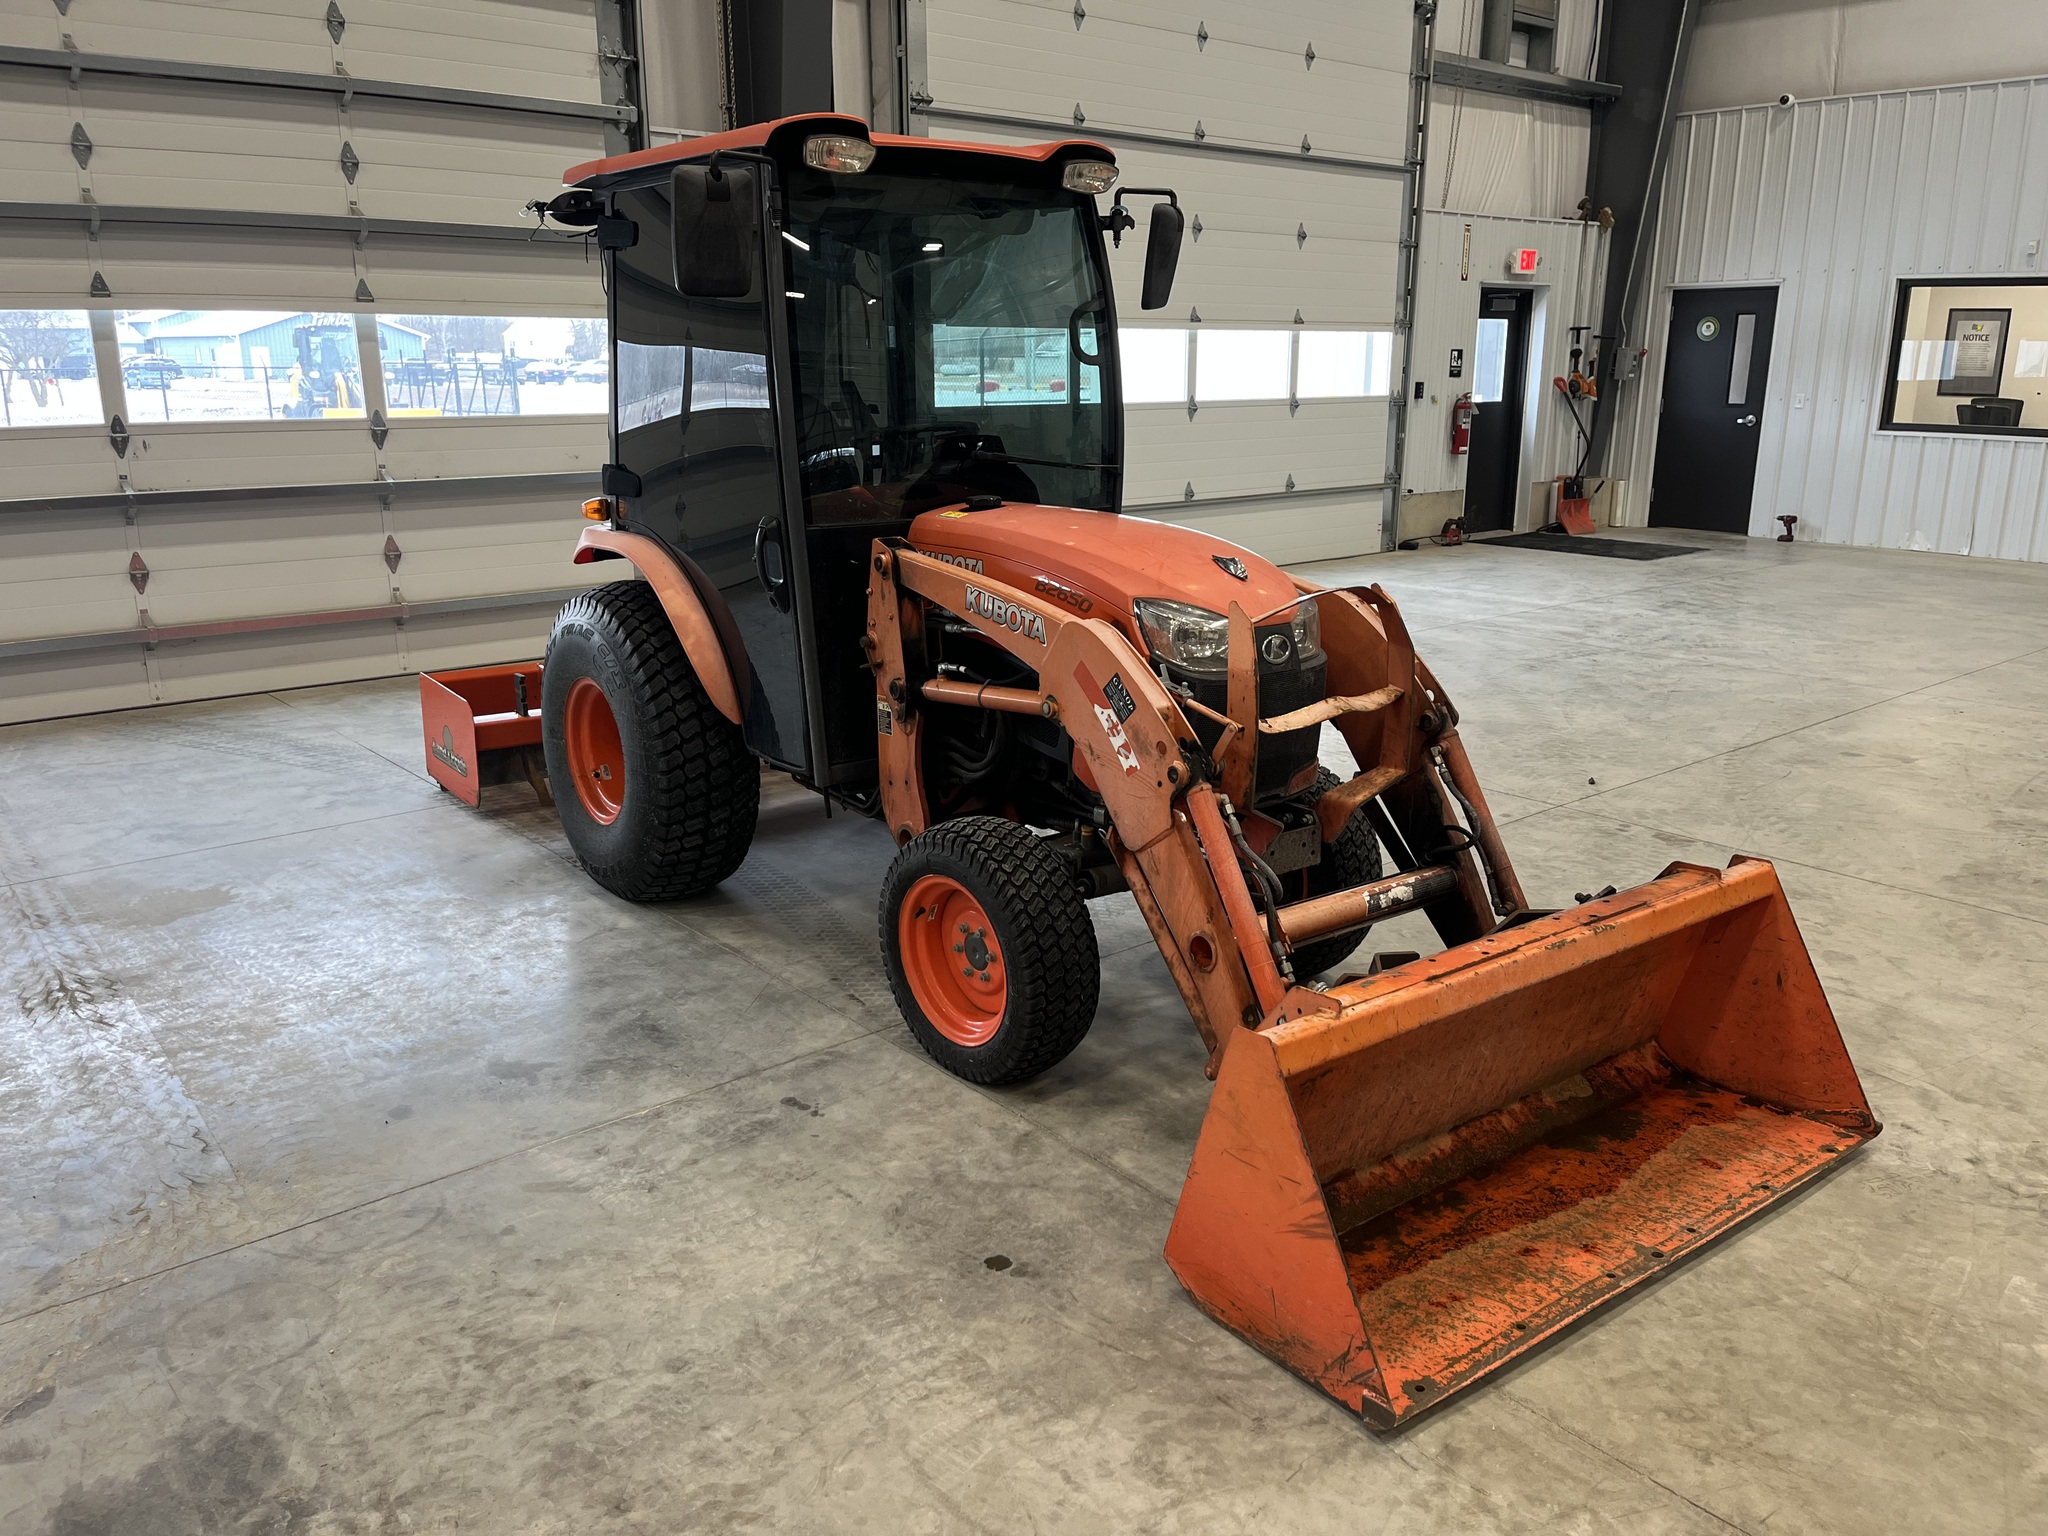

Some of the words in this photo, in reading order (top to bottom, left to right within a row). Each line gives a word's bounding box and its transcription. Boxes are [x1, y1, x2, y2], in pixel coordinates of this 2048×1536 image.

[1962, 333, 1991, 342] NOTICE
[1034, 576, 1094, 614] B2650
[965, 584, 1048, 647] KUBOTA
